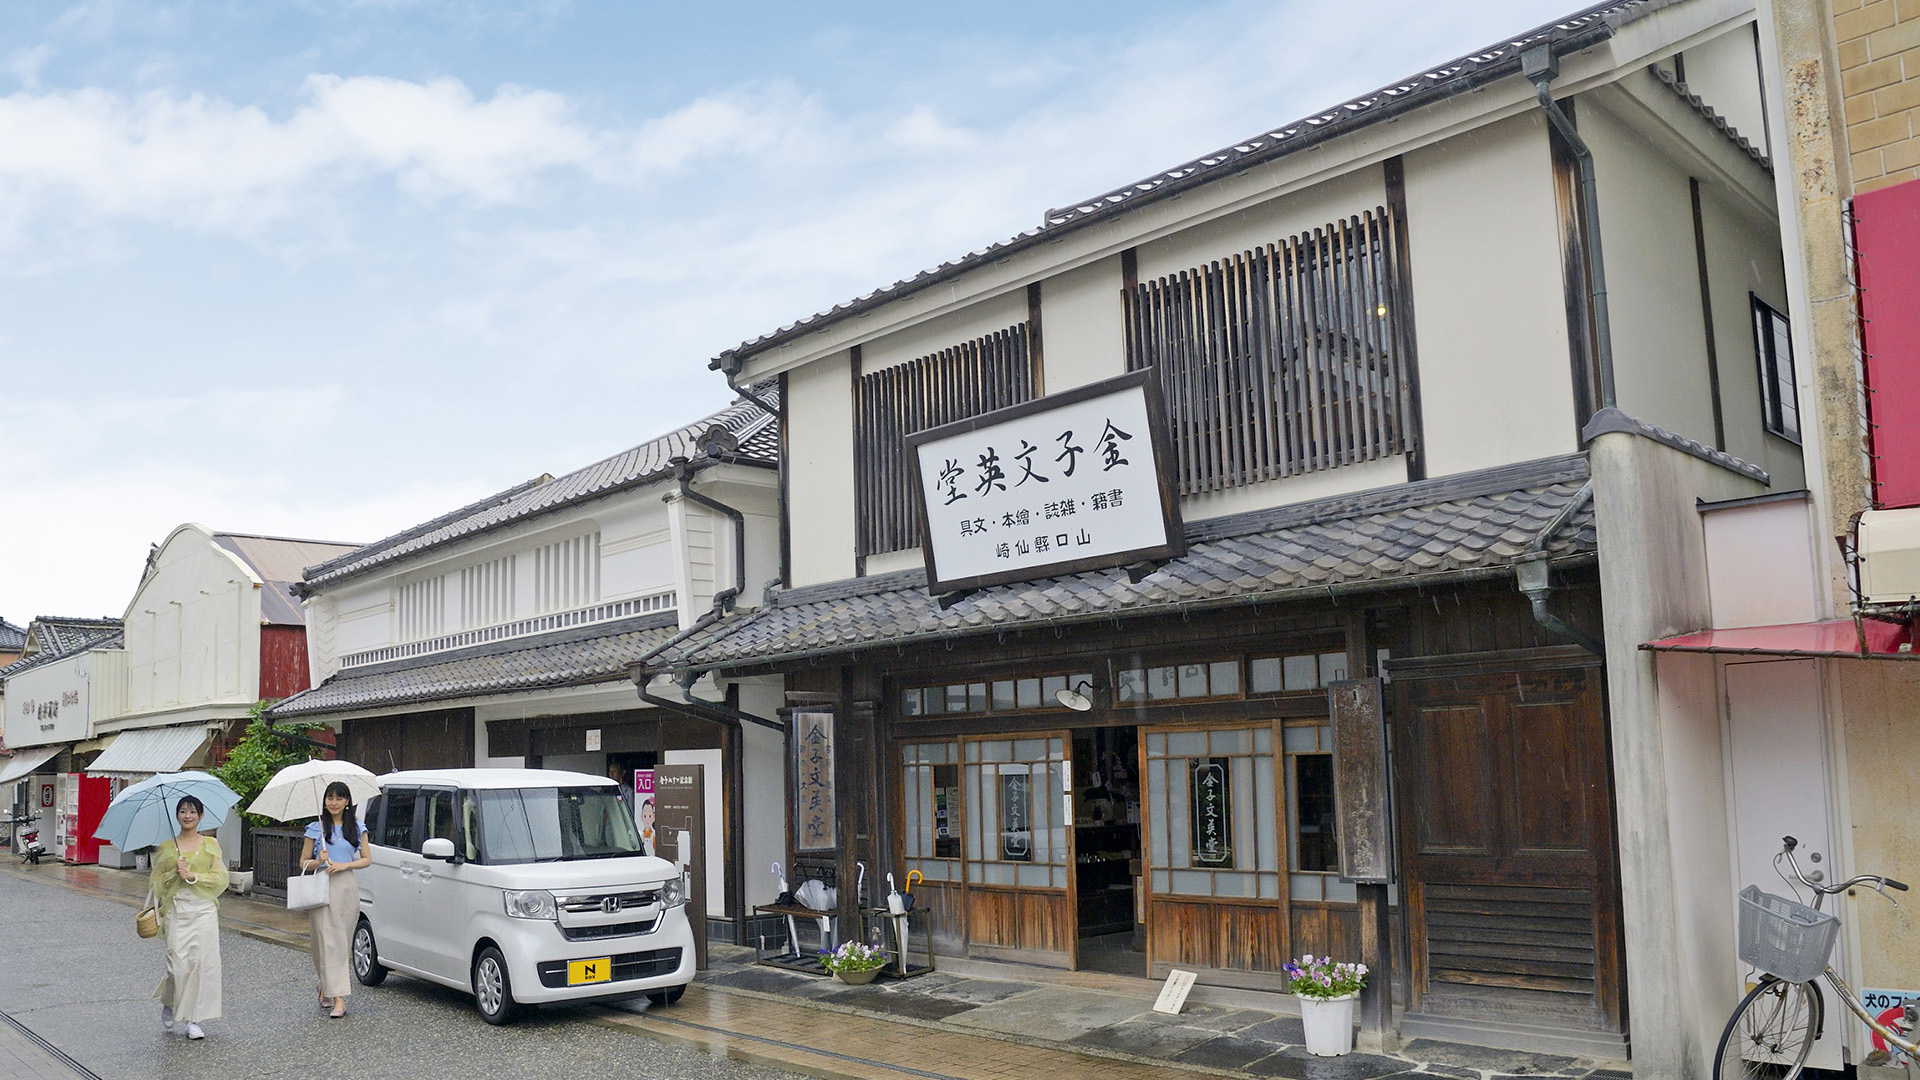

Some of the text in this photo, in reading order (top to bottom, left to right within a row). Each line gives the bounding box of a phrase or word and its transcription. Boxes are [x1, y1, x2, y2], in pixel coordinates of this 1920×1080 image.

[936, 417, 1133, 506] 金子文英堂
[805, 724, 828, 837] 金子文英堂
[1202, 772, 1219, 853] 金子文英堂
[585, 964, 596, 975] N
